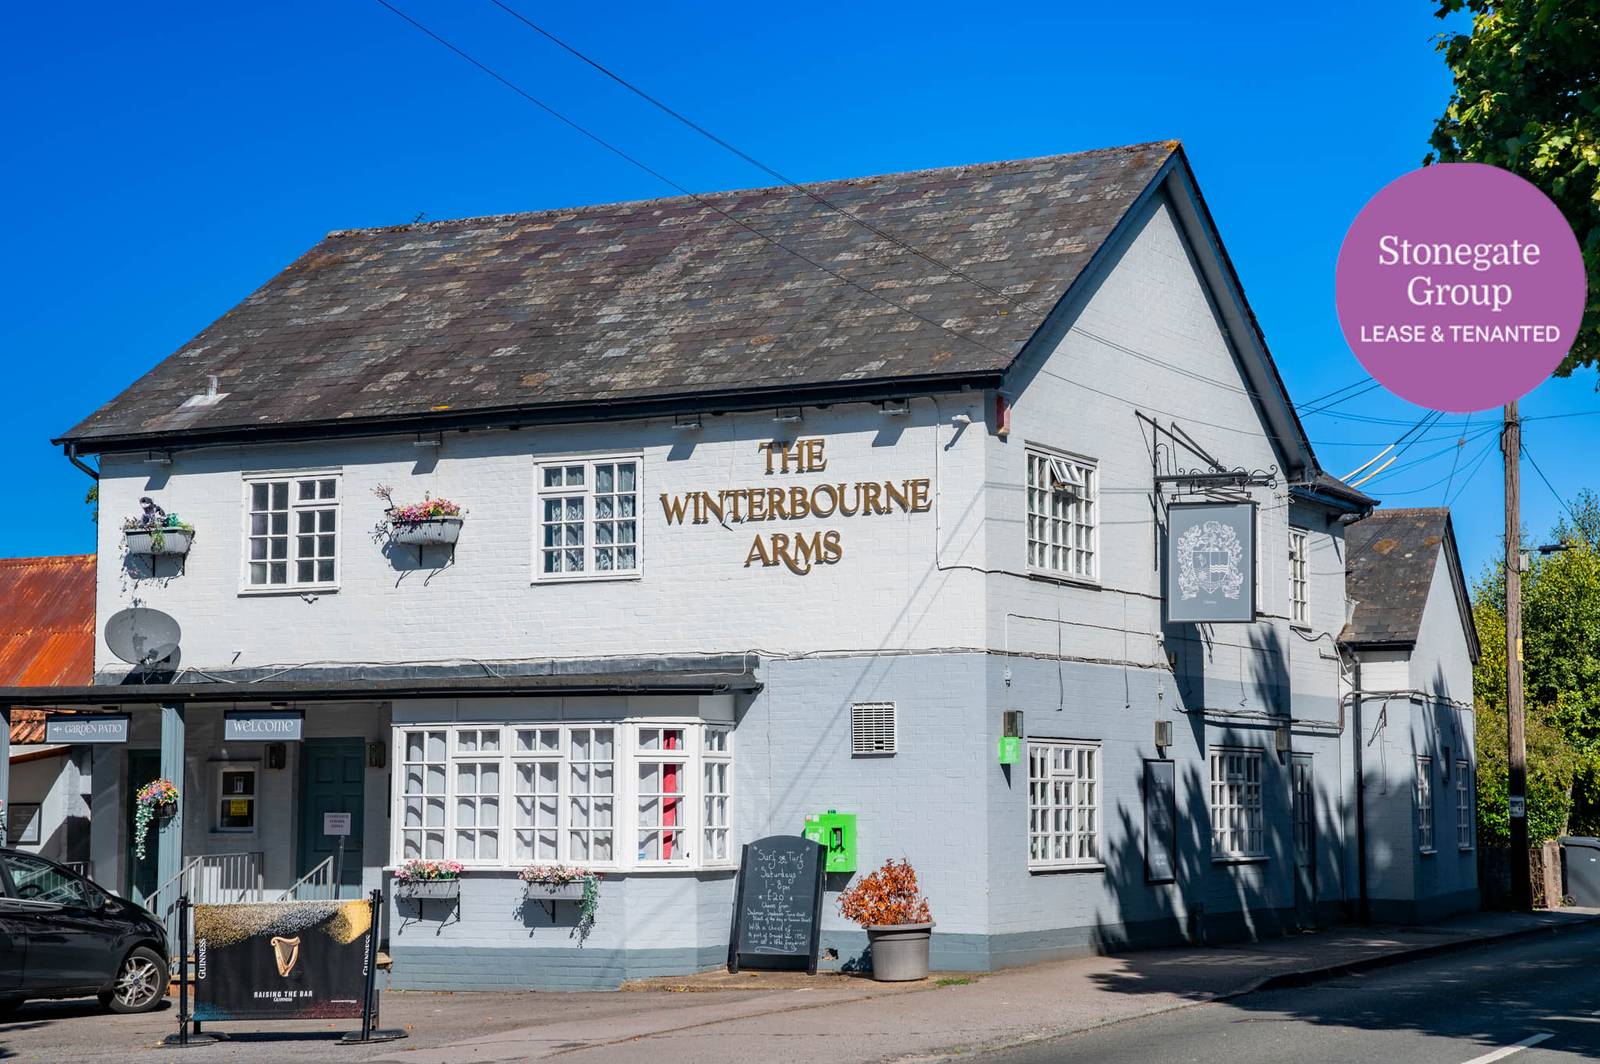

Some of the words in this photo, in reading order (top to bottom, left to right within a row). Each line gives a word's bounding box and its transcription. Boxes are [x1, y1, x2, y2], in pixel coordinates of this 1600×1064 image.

[758, 438, 828, 476] THE
[659, 478, 933, 526] WINTERBOURNE
[744, 530, 843, 576] ARMS
[758, 849, 777, 869] Surf
[786, 851, 804, 869] Turf
[760, 866, 797, 884] Saturdays
[197, 938, 207, 980] GUINNESS
[253, 991, 282, 999] RAISING
[284, 990, 297, 998] THE
[299, 990, 313, 998] BAR
